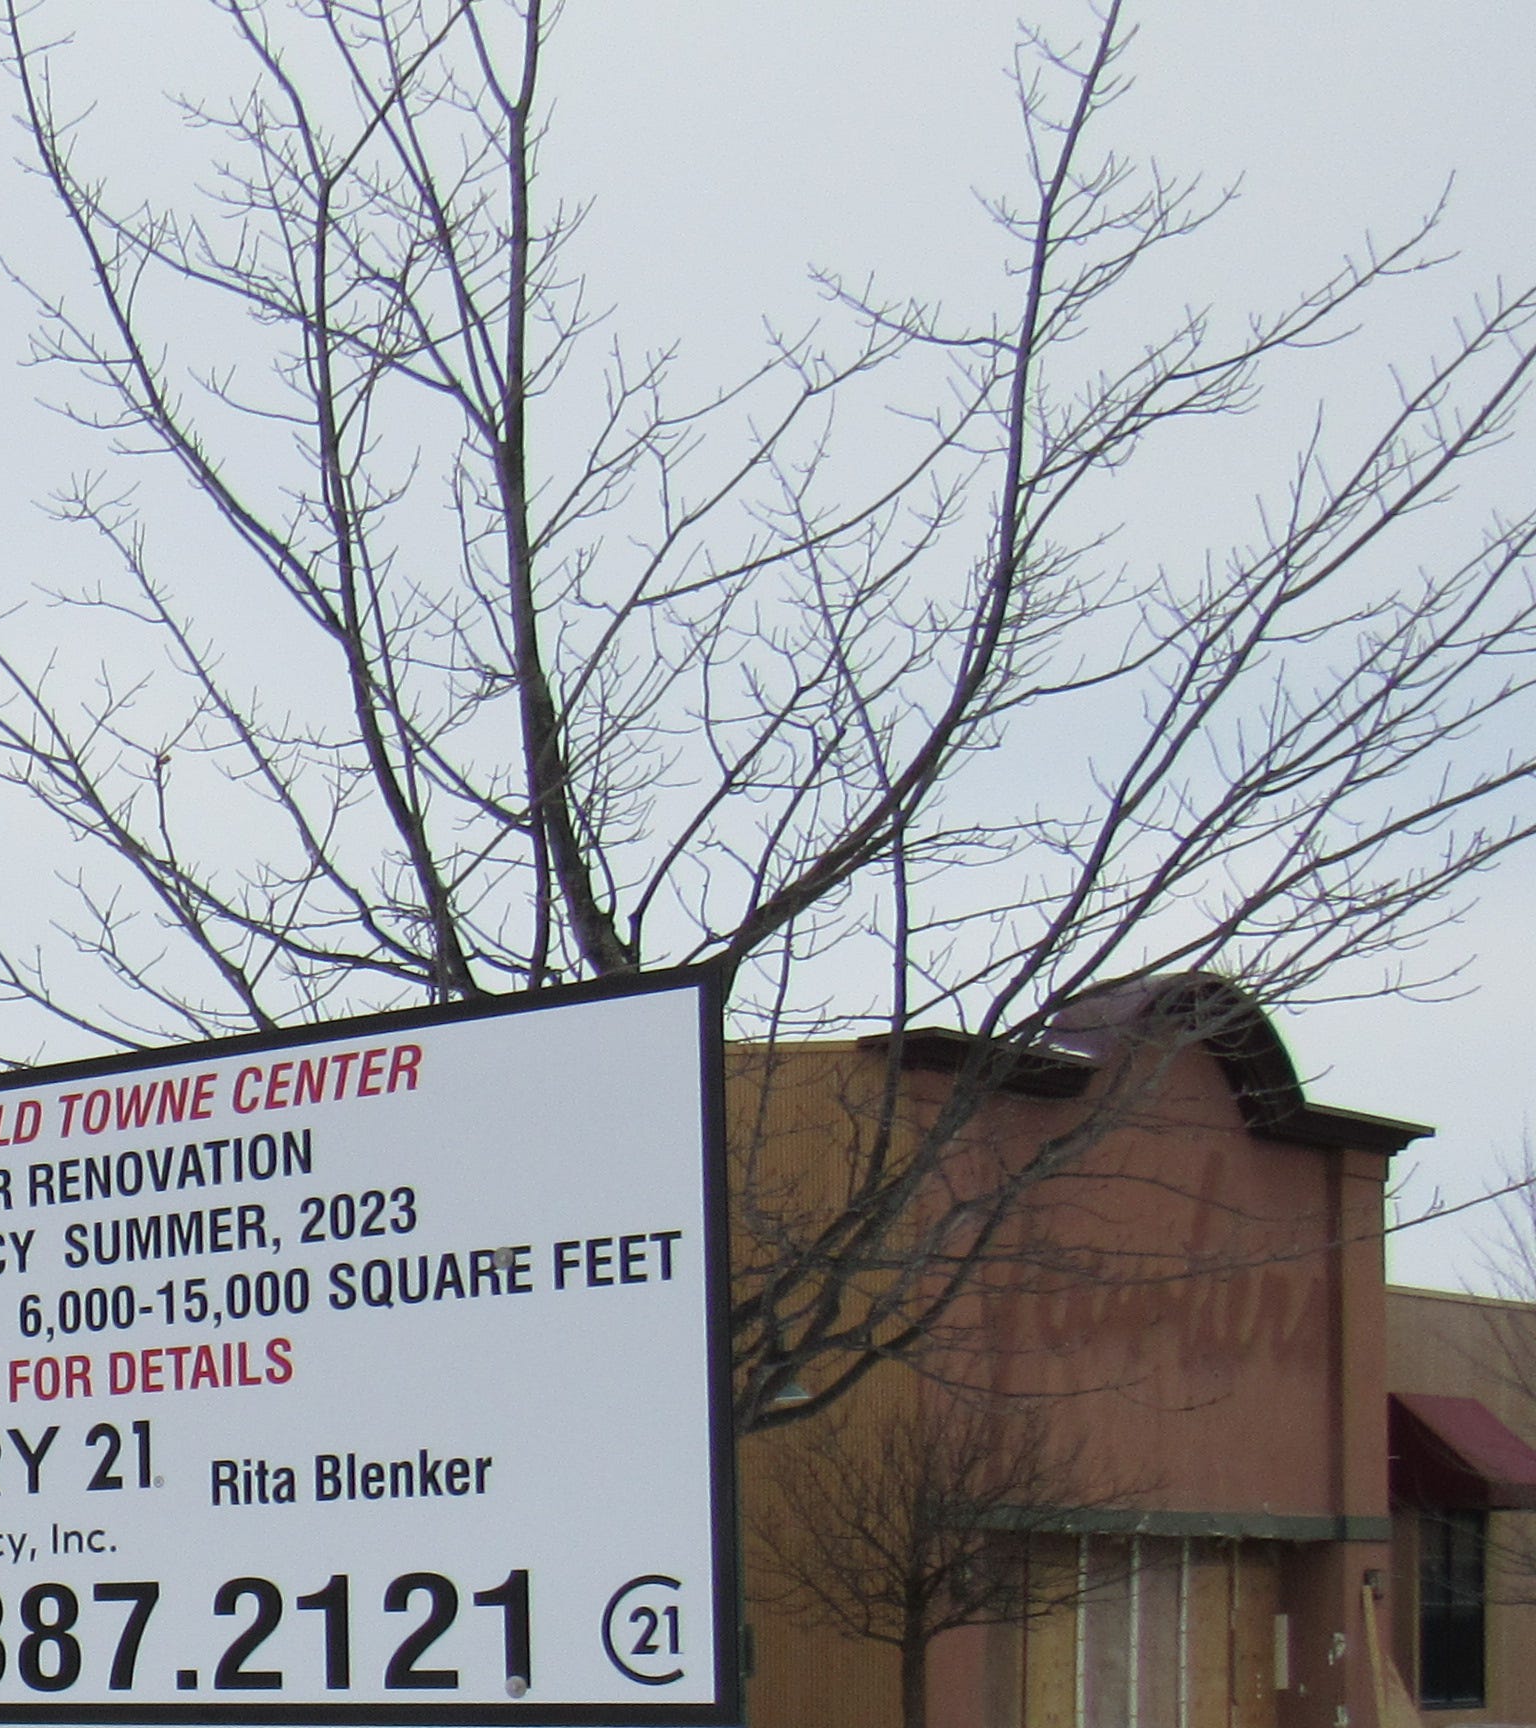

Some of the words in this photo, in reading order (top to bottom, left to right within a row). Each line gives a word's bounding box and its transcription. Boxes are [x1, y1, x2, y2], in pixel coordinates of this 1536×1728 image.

[58, 1081, 218, 1139] TOWNE
[232, 1044, 423, 1115] CENTER
[28, 1128, 312, 1208] RENOVATION
[64, 1203, 282, 1269] SUMMER,
[300, 1186, 417, 1244] 2023
[19, 1277, 310, 1342] 6,000-15,000
[328, 1245, 534, 1311] SQUARE
[553, 1230, 683, 1291] FEET
[8, 1354, 93, 1403] FOR
[109, 1337, 293, 1396] DETAILS
[85, 1419, 151, 1492] 21
[211, 1459, 296, 1507] Rita
[314, 1448, 493, 1502] Blenker
[52, 1523, 118, 1555] Inc.
